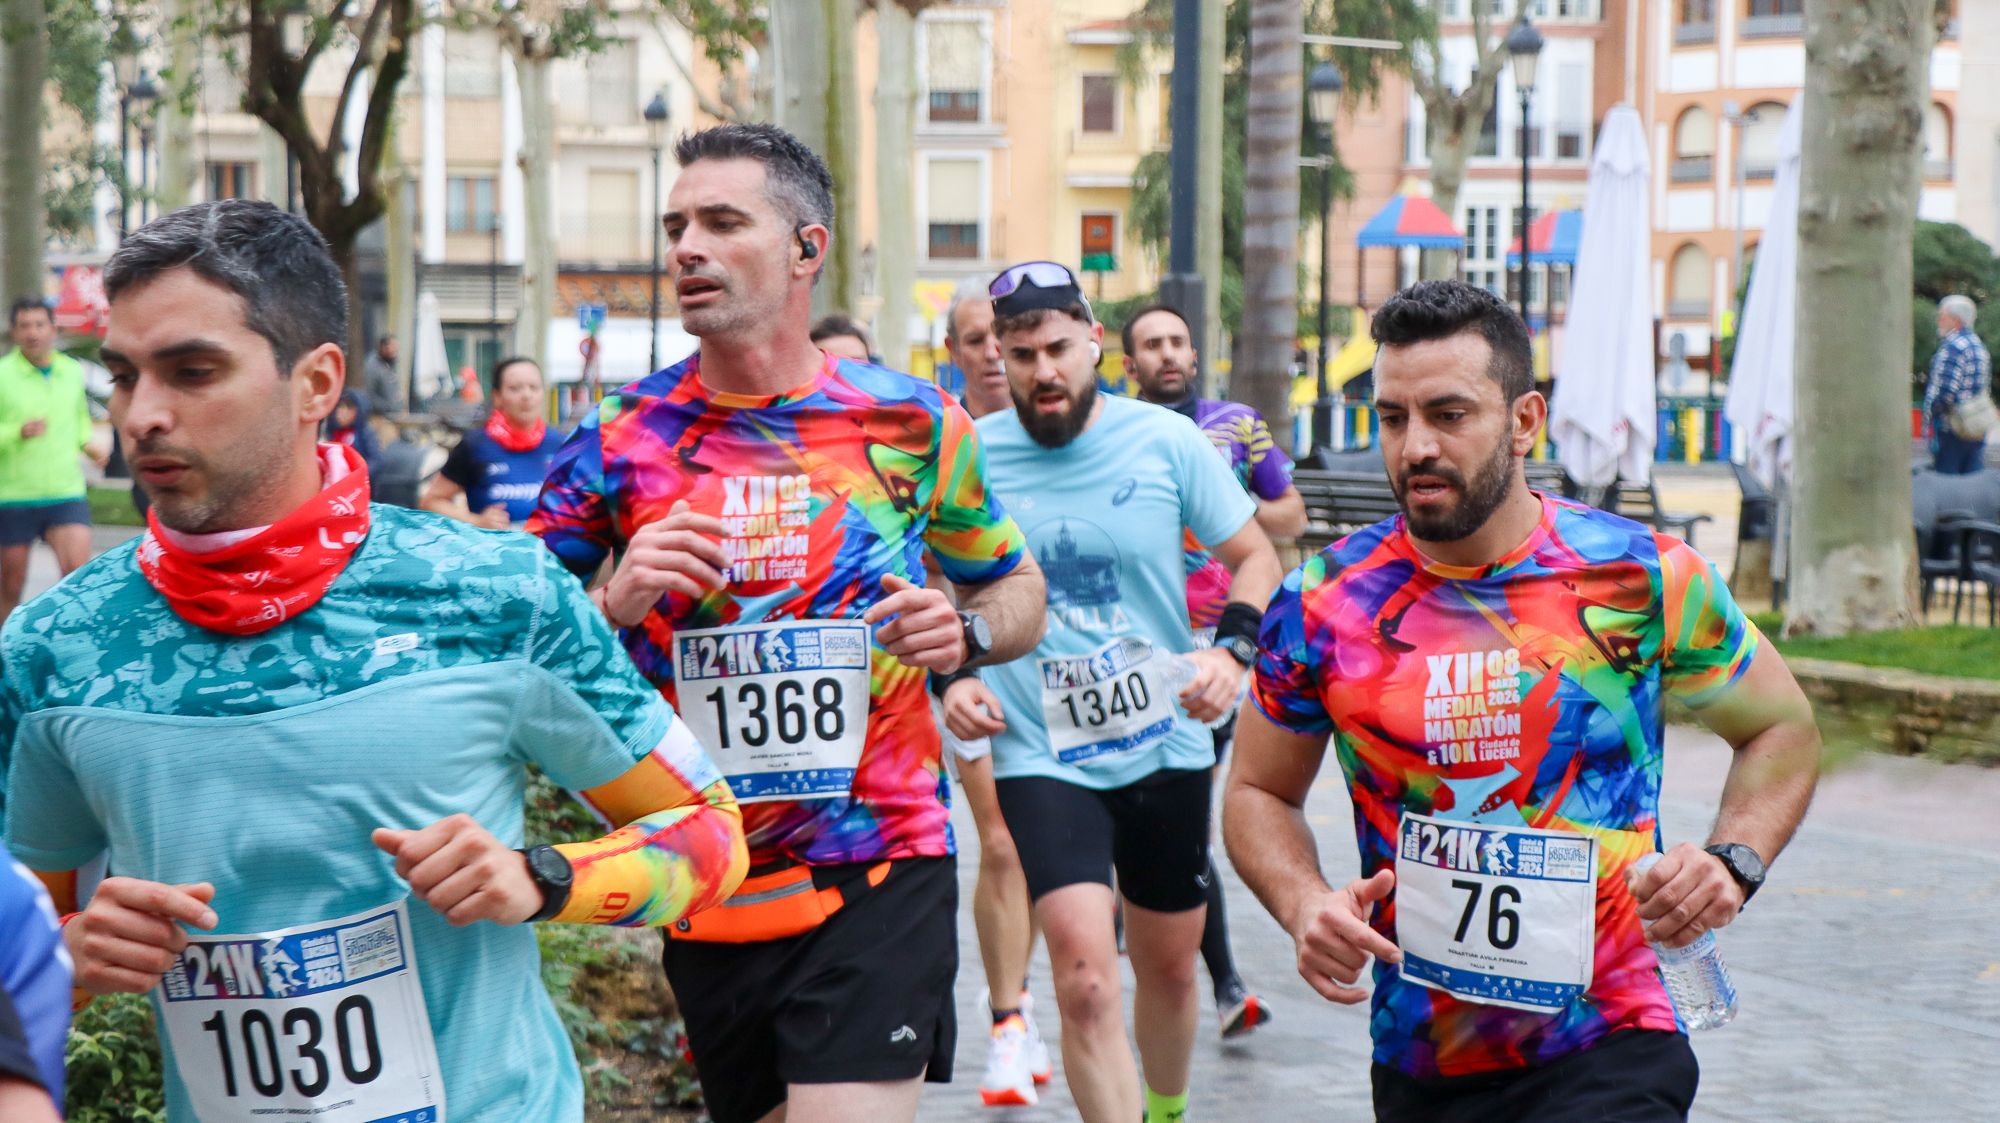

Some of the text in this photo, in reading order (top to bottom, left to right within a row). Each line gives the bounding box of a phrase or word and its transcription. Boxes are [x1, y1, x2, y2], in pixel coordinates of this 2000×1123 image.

[721, 475, 777, 516] XII
[779, 473, 811, 500] 08
[721, 514, 780, 537] MEDIA
[720, 530, 810, 560] MARATÓN
[733, 559, 767, 582] 10K
[700, 632, 762, 677] 21K
[796, 654, 820, 668] 2026
[1486, 647, 1521, 677] 08
[1424, 651, 1484, 697] XII
[706, 676, 845, 749] 1368
[1061, 671, 1151, 728] 1340
[1423, 694, 1488, 720] MEDIA
[1487, 689, 1521, 706] 2026
[1424, 709, 1521, 743] MARATÓN
[1427, 741, 1477, 766] & 10K
[1479, 737, 1520, 750] Ciudad de
[1479, 746, 1521, 762] LUCENA
[1420, 823, 1482, 873] 21K
[1517, 862, 1543, 877] 2026
[1451, 879, 1522, 951] 76
[185, 943, 265, 998] 21K
[305, 965, 343, 990] 2026
[203, 994, 383, 1098] 1030
